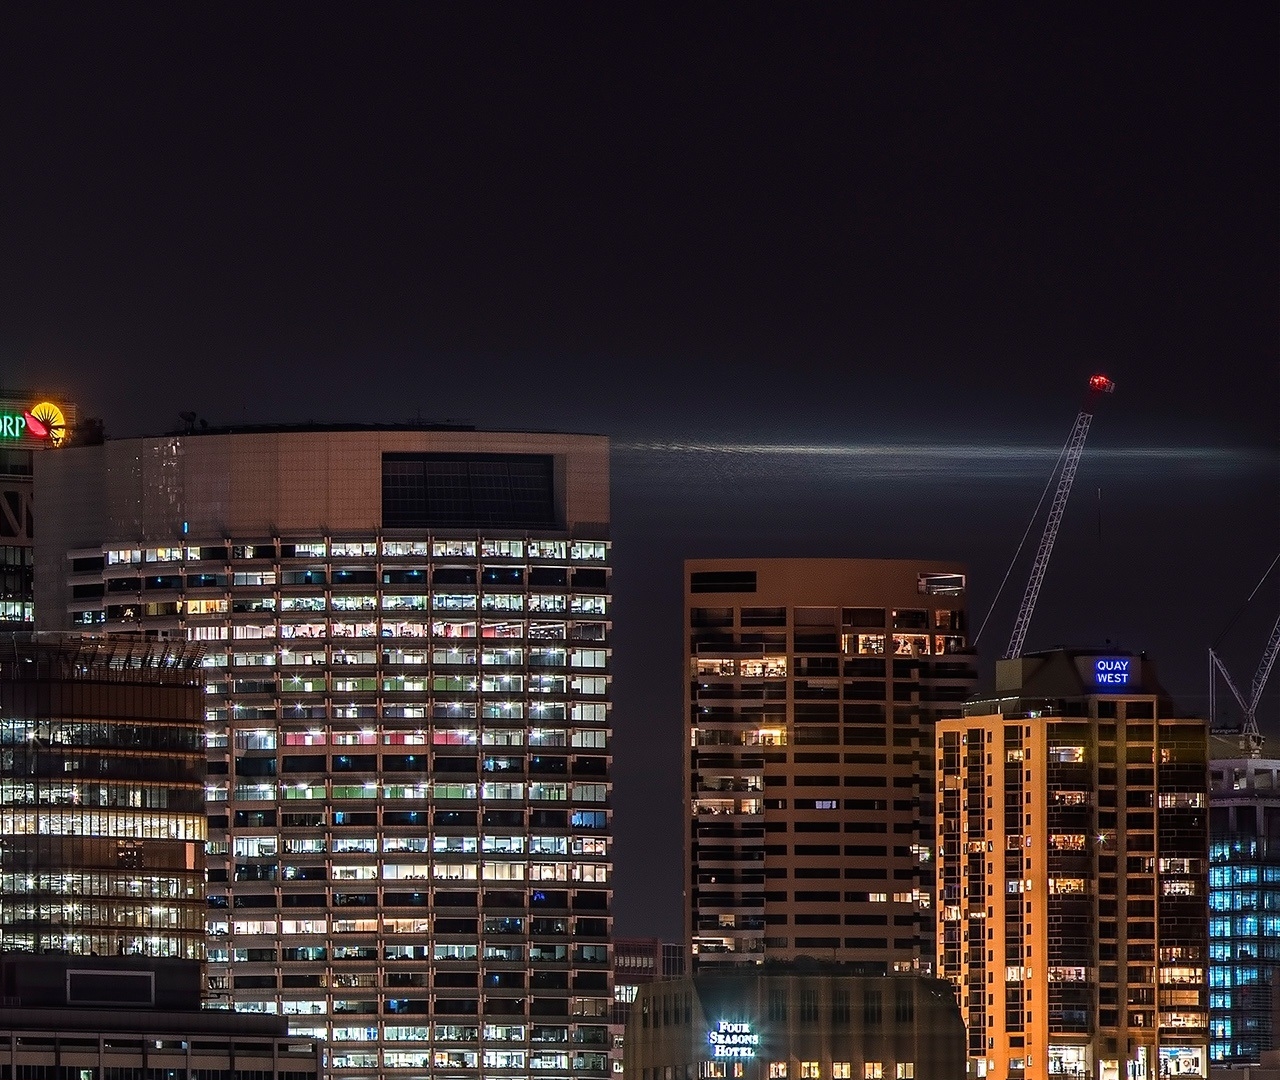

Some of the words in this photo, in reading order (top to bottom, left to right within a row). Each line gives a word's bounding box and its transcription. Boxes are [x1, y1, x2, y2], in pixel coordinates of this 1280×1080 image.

[1097, 660, 1129, 671] QUAY
[1097, 673, 1129, 683] WEST
[718, 1021, 751, 1033] FOUR
[709, 1031, 759, 1045] SEASONS
[714, 1045, 755, 1057] HOTEL
